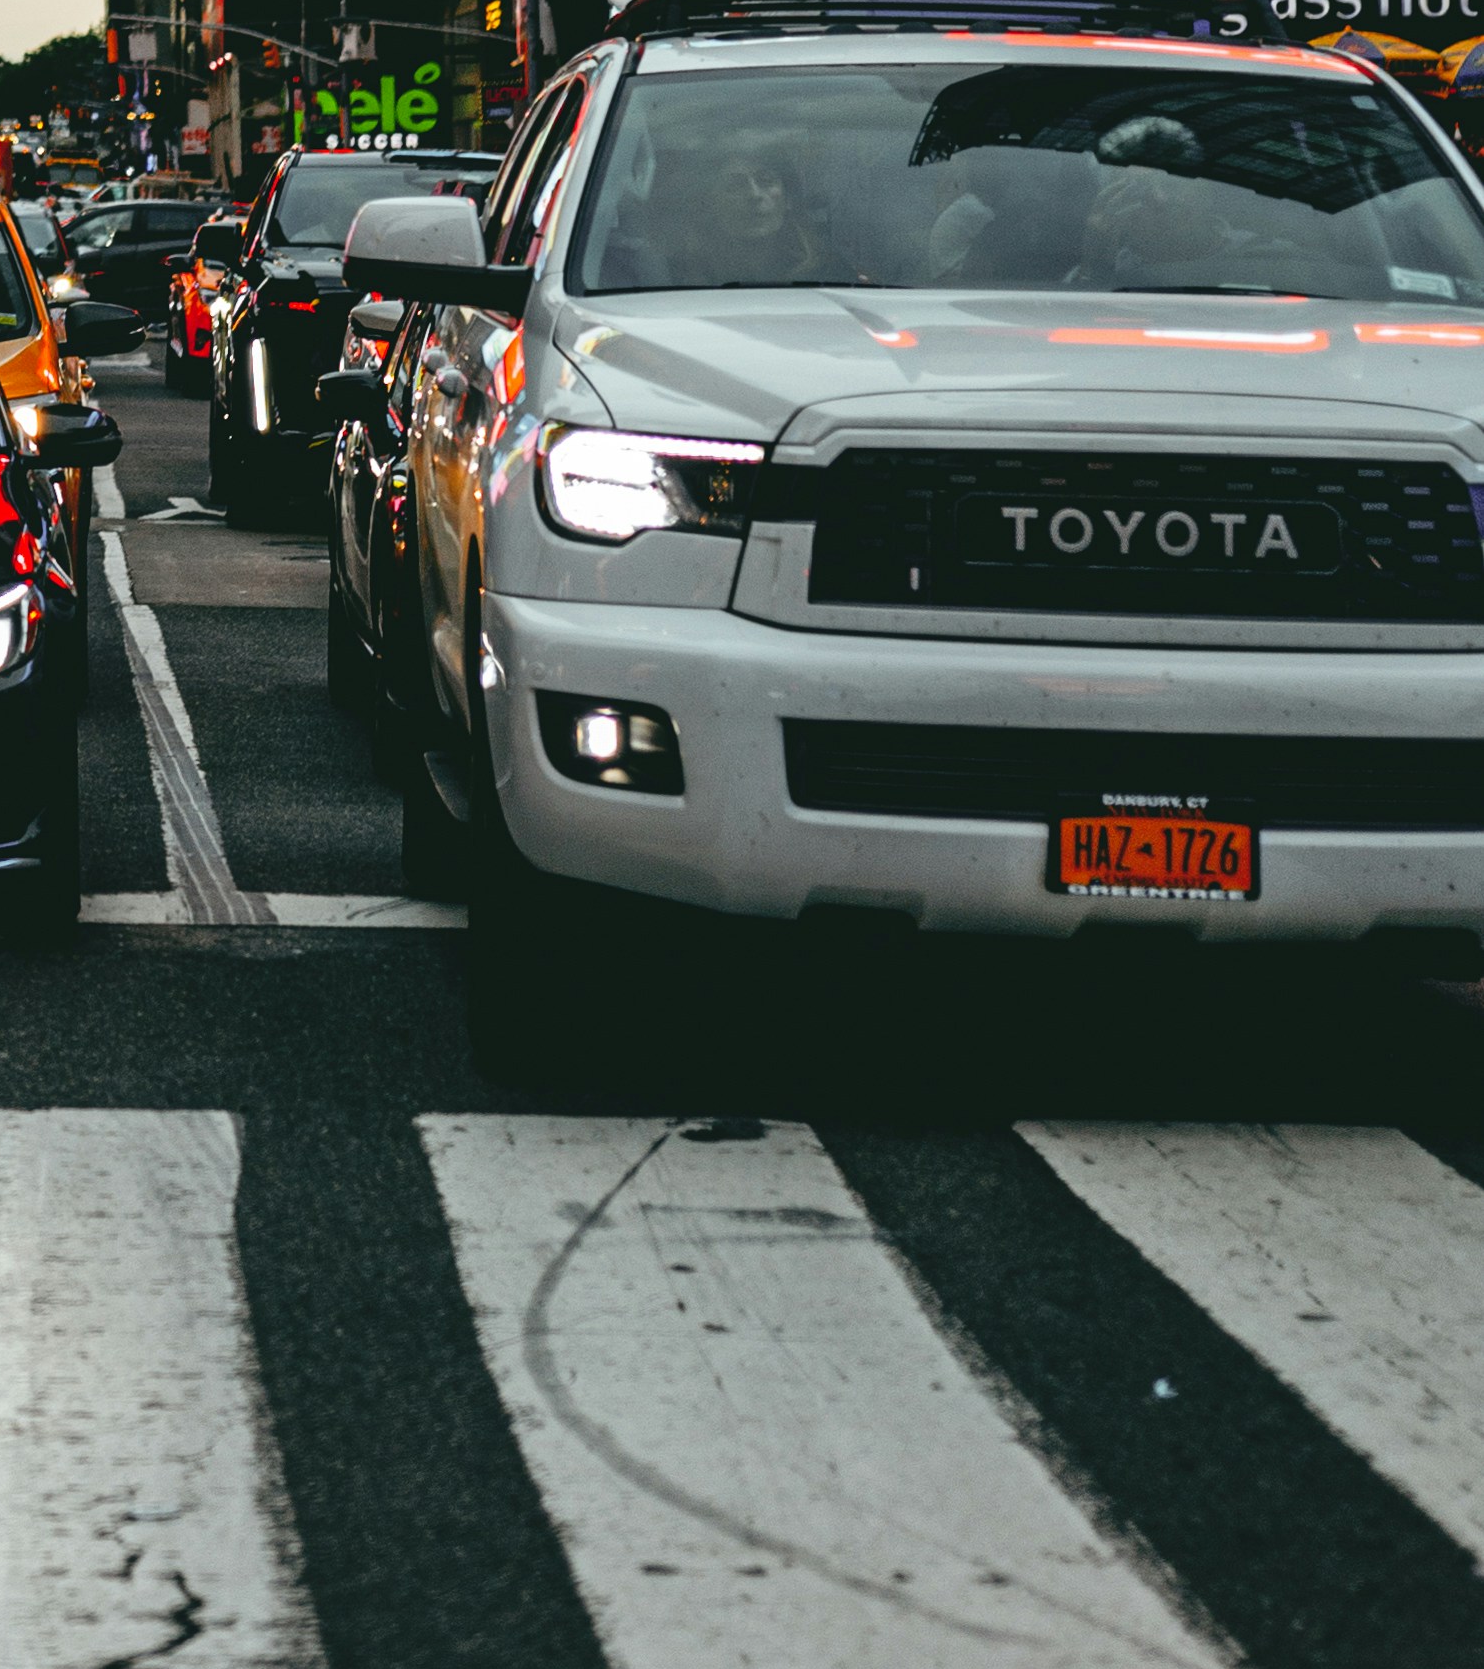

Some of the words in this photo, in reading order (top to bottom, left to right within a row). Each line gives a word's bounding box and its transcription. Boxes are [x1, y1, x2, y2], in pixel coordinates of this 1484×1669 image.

[327, 133, 419, 150] SCCER
[1000, 506, 1300, 560] TOYOTA
[1074, 823, 1133, 872] HAZ
[1163, 827, 1240, 877] 1726
